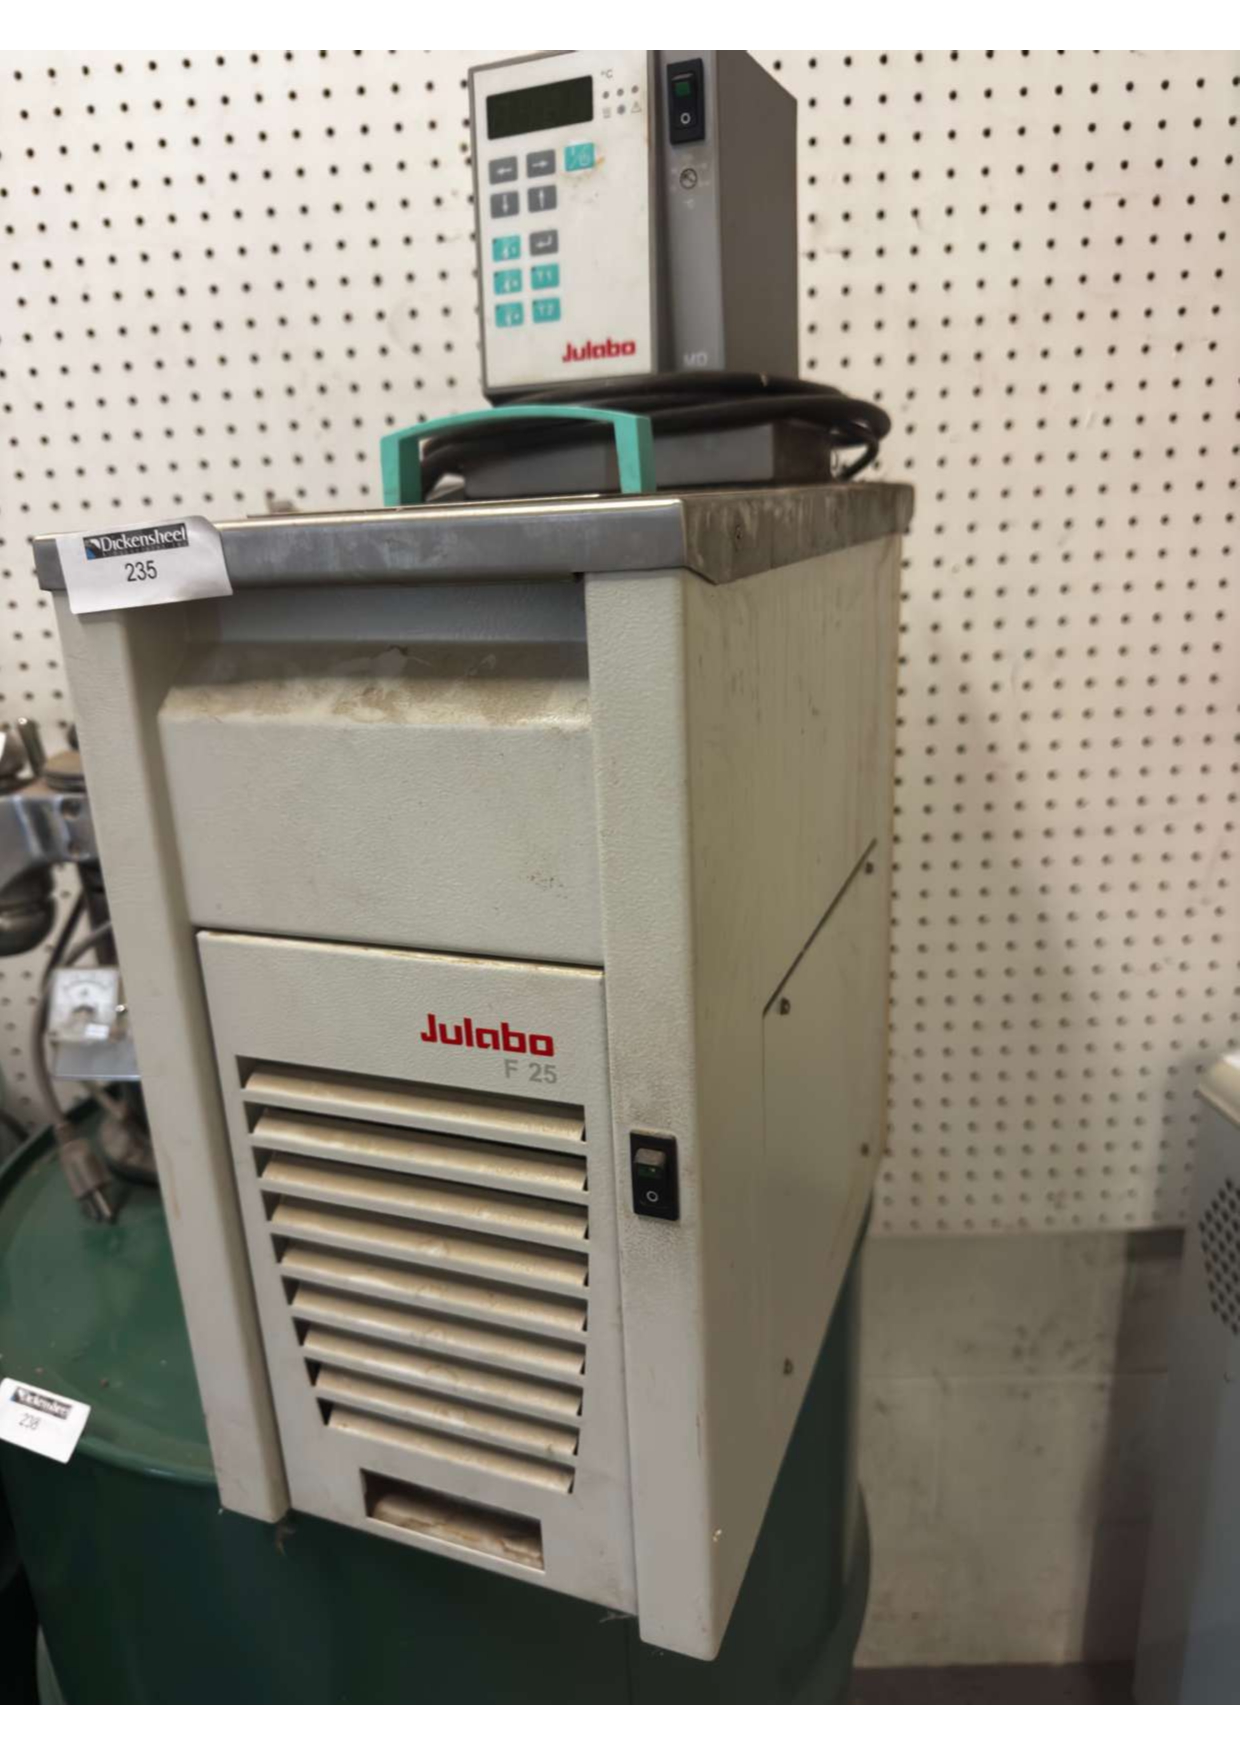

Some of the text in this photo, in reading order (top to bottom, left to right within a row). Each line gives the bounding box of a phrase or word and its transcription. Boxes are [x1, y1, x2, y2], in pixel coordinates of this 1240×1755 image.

[562, 337, 636, 363] Julabo
[100, 527, 187, 552] Dickensheel
[125, 560, 158, 582] 235
[420, 1013, 555, 1058] Julabo
[504, 1059, 557, 1084] F 25
